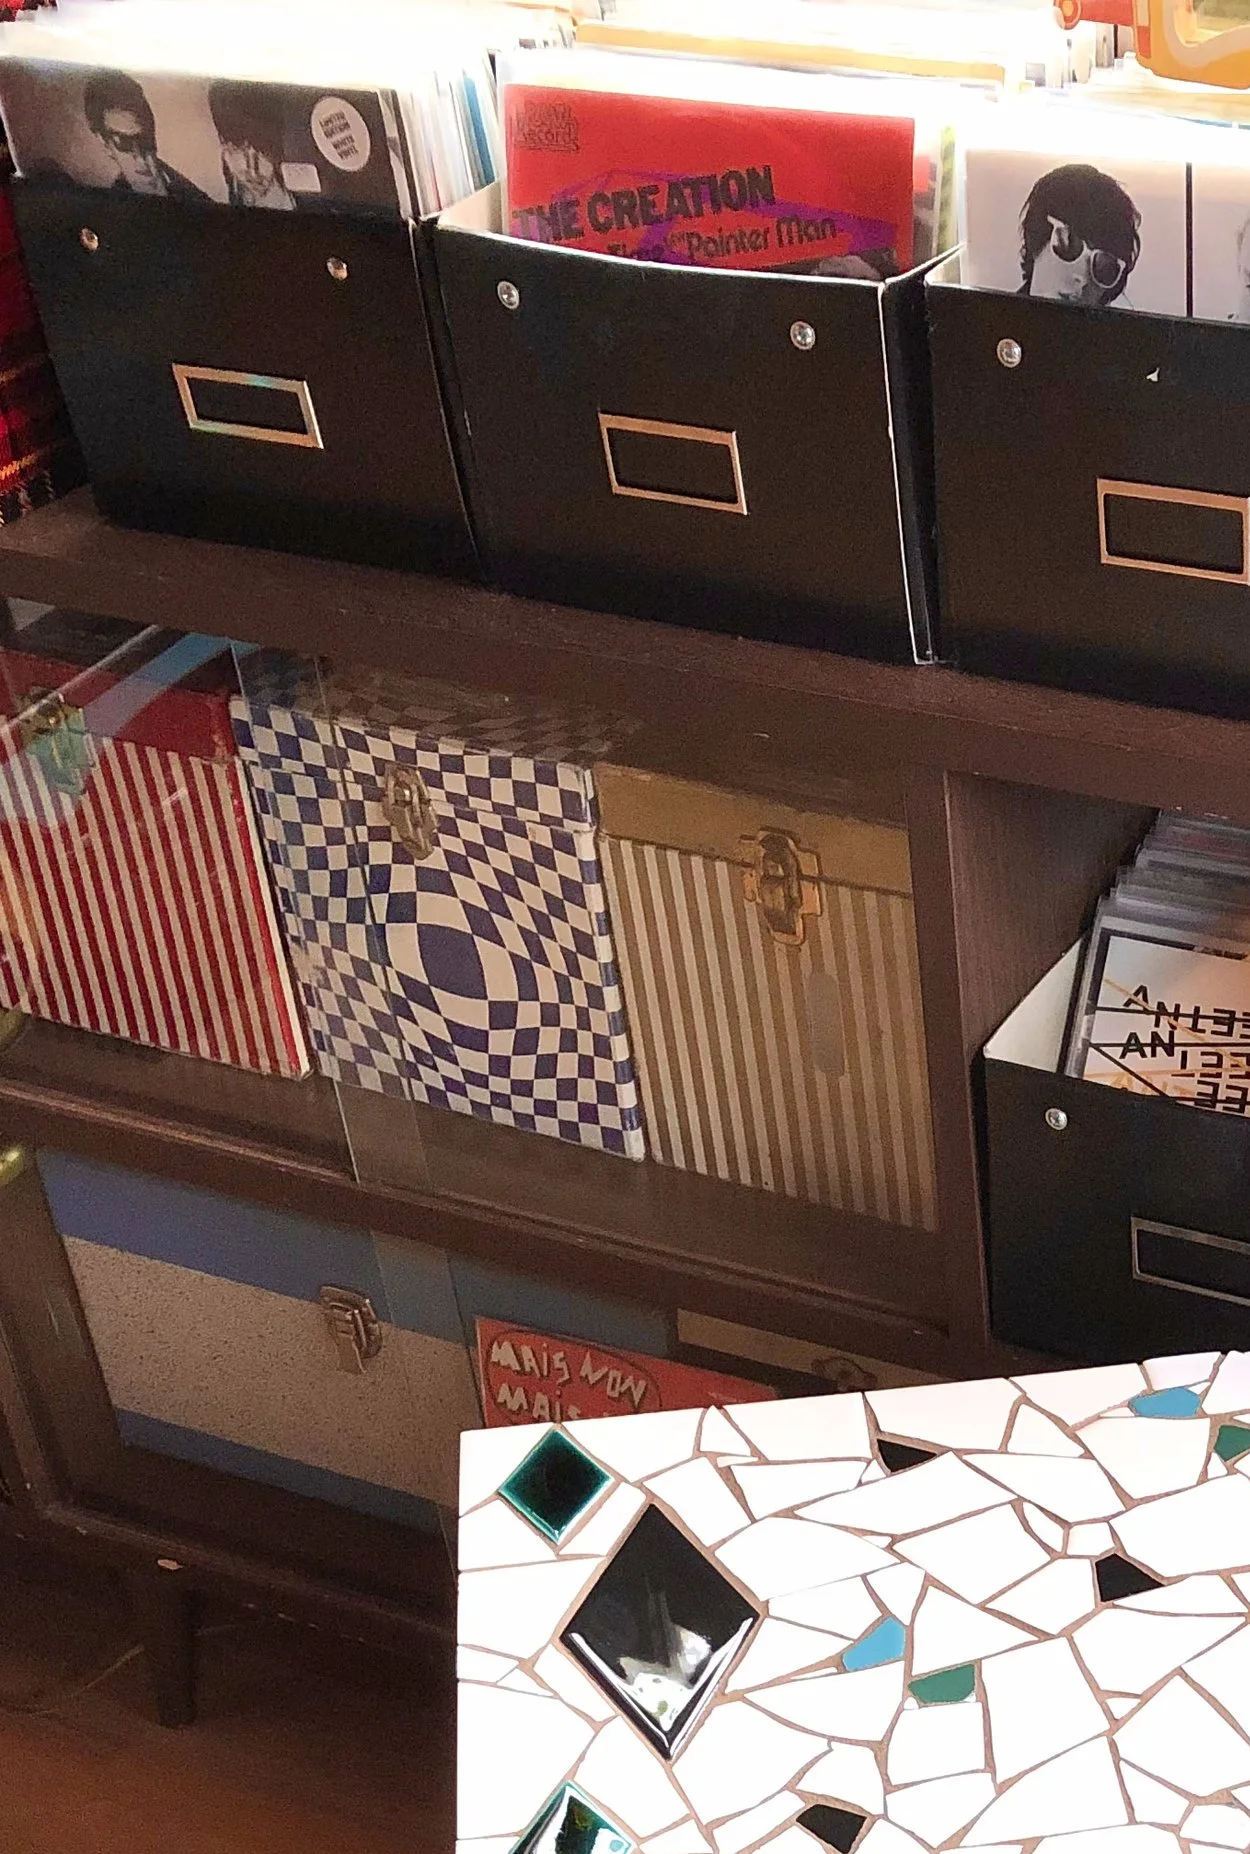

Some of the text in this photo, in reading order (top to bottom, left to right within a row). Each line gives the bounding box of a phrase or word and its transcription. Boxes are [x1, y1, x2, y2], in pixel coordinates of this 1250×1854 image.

[513, 164, 776, 243] THE CREATION
[775, 215, 838, 247] Man
